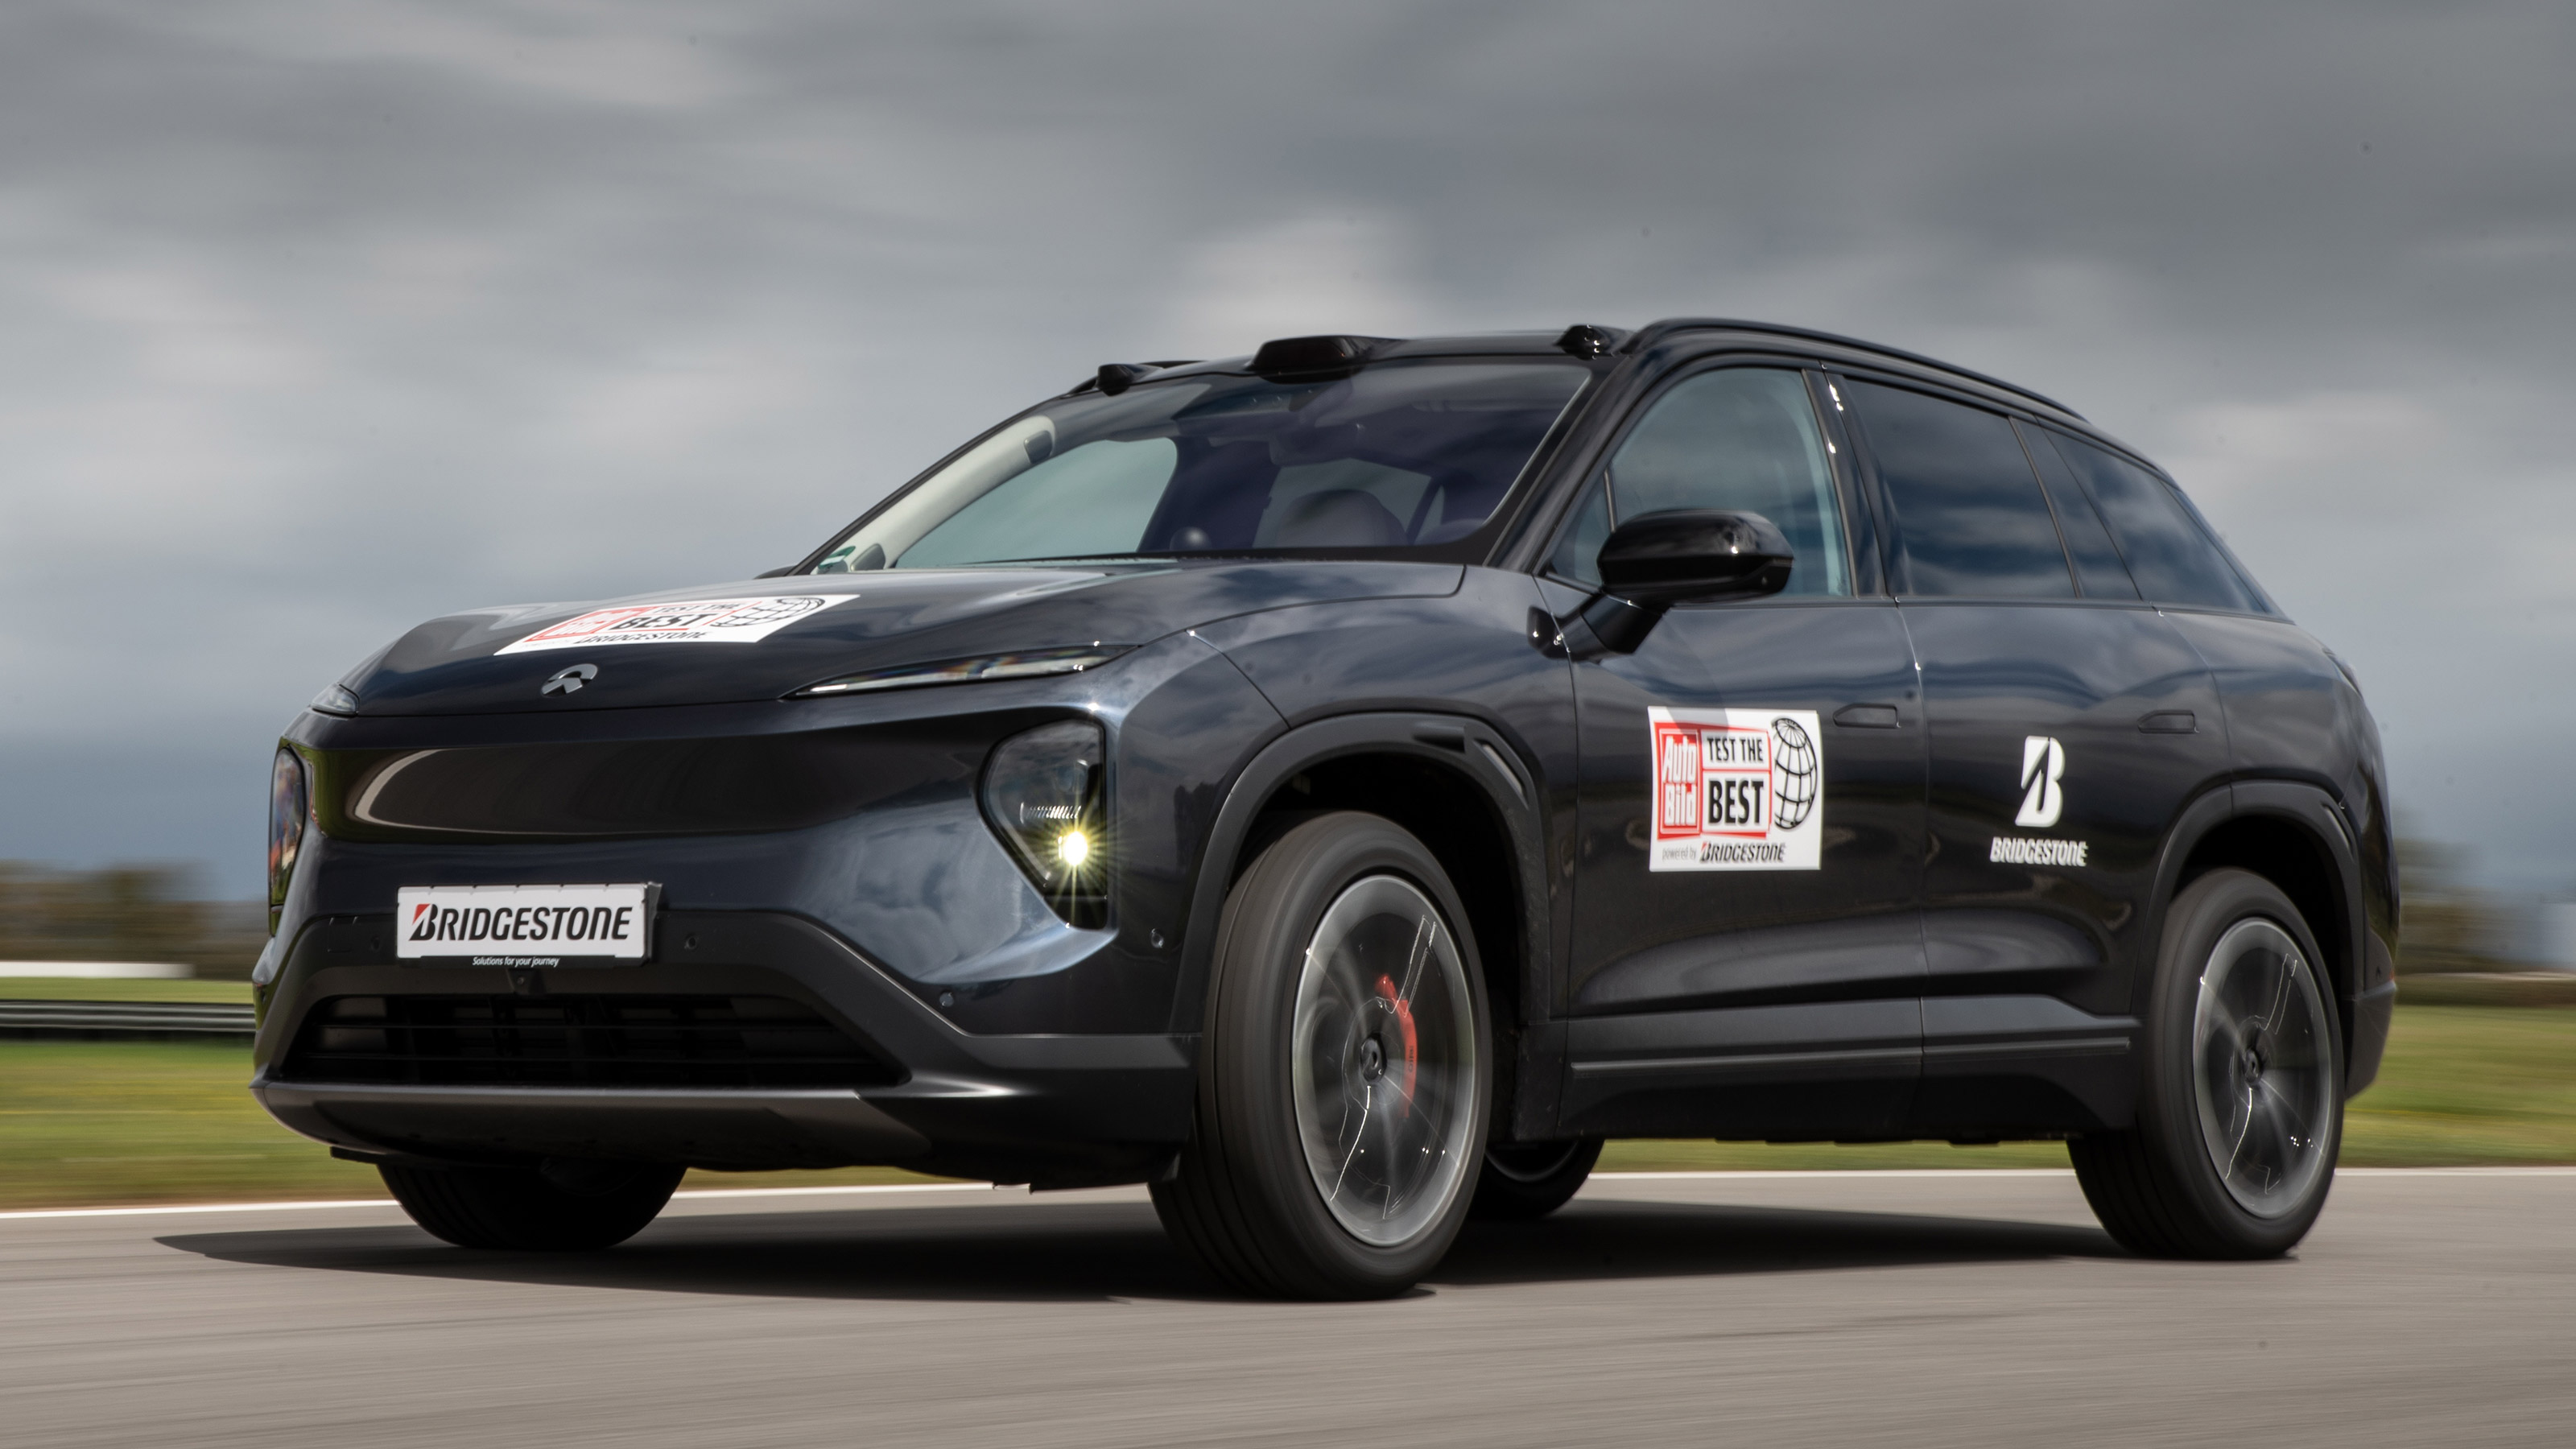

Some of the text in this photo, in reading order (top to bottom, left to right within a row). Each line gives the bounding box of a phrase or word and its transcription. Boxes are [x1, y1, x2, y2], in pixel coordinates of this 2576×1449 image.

[609, 613, 718, 630] BEST
[573, 632, 707, 644] BRIDGESTONE
[1662, 736, 1697, 782] Auto
[1707, 737, 1764, 762] TEST THE
[1664, 783, 1697, 826] Bild
[1707, 780, 1764, 824] BEST
[1662, 842, 1785, 862] powered by BRIDGESTONE
[1990, 836, 2088, 867] BRIDGESTONE
[408, 903, 632, 941] BRIDGESTONE
[473, 956, 560, 968] Solutions for your journey
